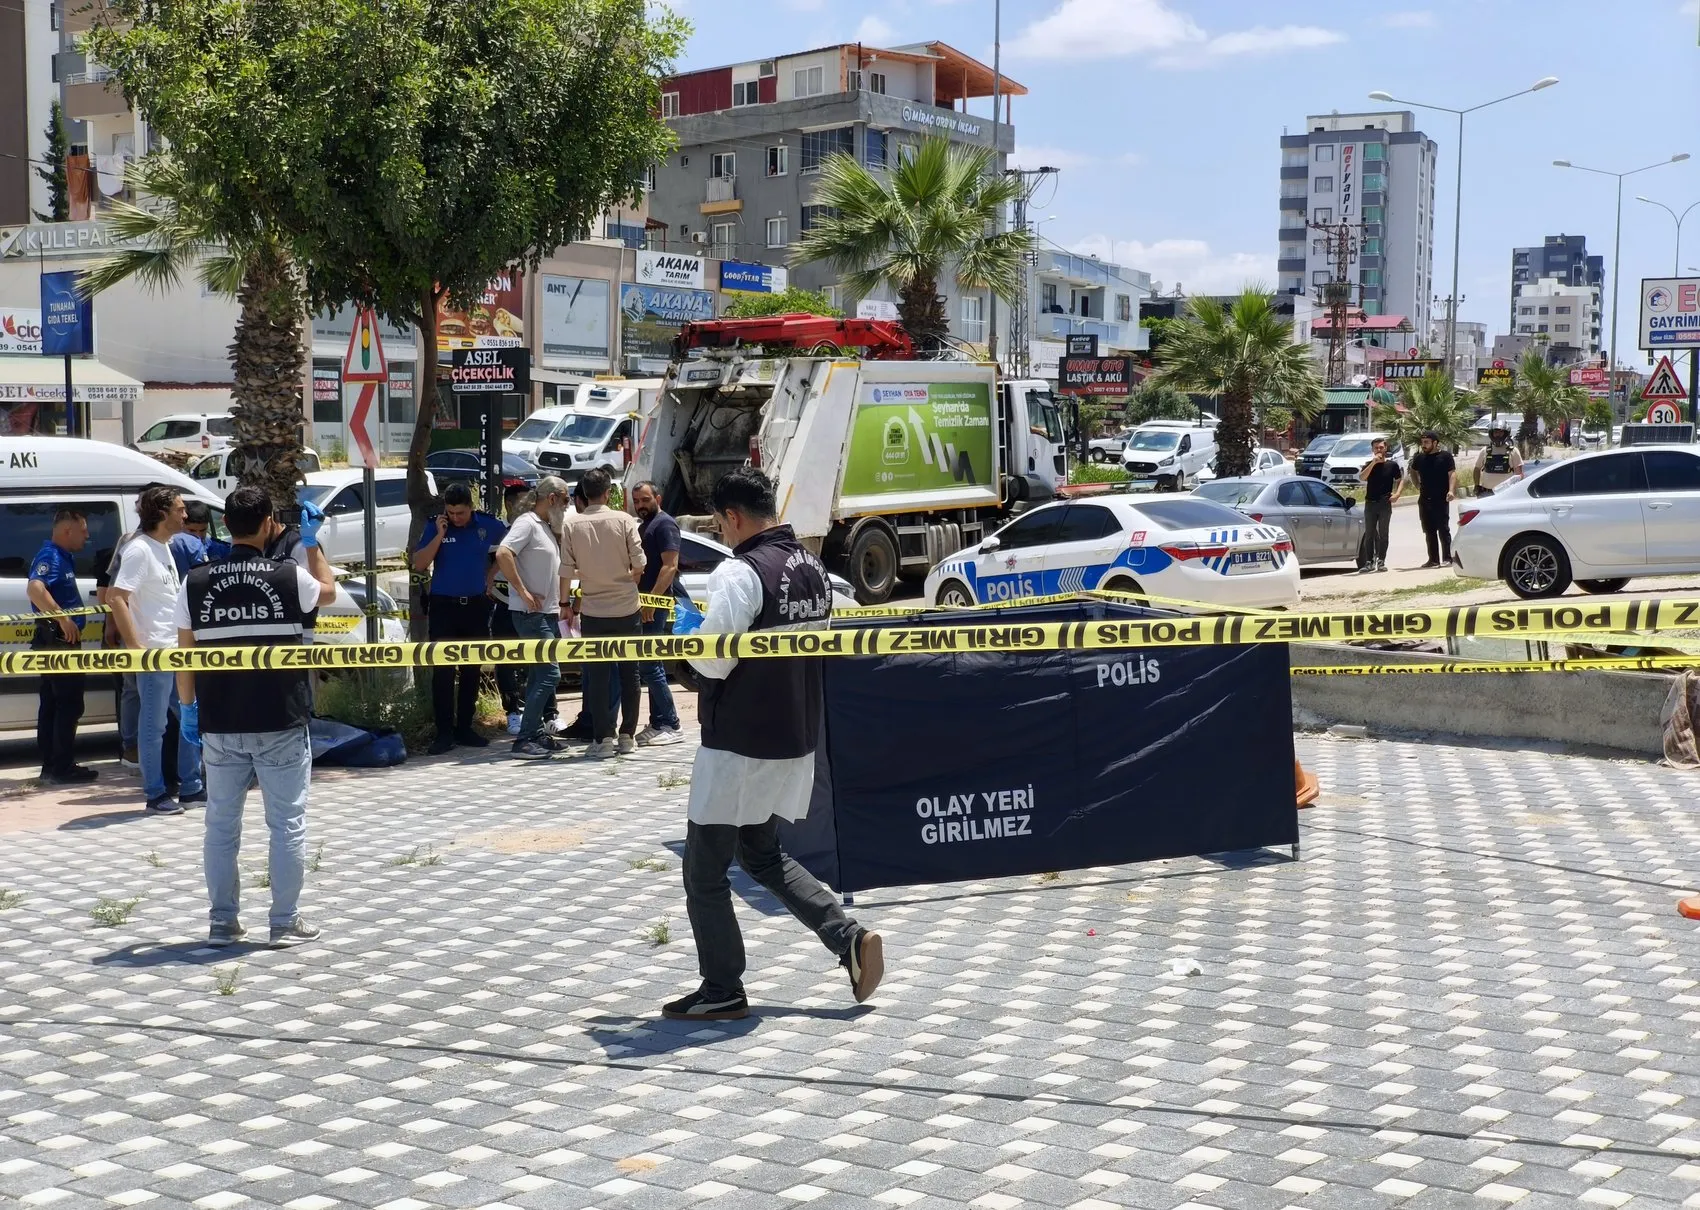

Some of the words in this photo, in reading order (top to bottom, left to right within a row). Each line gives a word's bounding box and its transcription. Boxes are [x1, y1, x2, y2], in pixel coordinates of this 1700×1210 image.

[911, 109, 935, 128] MİRAÇ
[656, 256, 699, 272] AKANA
[665, 271, 691, 280] TARIM
[547, 283, 567, 294] ANT
[49, 301, 76, 312] TUNAHAN
[649, 292, 704, 312] AKANA
[47, 315, 61, 324] GIDA
[61, 313, 78, 323] TEKEL
[662, 311, 693, 321] TARIM
[464, 350, 502, 365] ASEL
[1066, 359, 1099, 371] UMUT
[1101, 359, 1124, 371] OTO
[451, 365, 515, 383] ÇİÇEKÇİLİK
[1066, 373, 1094, 382] LASTİK
[1096, 373, 1102, 382] &
[1104, 371, 1122, 382] AKÜ
[932, 401, 969, 415] Seyhan'da
[1654, 408, 1674, 424] 30
[933, 415, 963, 428] Temizlik
[963, 416, 989, 426] Zamanı
[1132, 531, 1145, 541] 112
[208, 560, 274, 575] KRİMİNAL
[1235, 553, 1243, 563] 01
[1247, 553, 1252, 562] A
[200, 590, 216, 623] OLAY
[213, 572, 240, 593] YERİ
[243, 572, 284, 619] İNCELEME
[779, 571, 791, 615] OLAY
[986, 574, 1034, 602] POLİS
[214, 603, 269, 622] POLİS
[788, 594, 826, 621] POLİS
[1255, 613, 1433, 639] GİRİLMEZ
[1492, 606, 1611, 631] POLİS
[15, 629, 32, 637] OLAY
[889, 626, 1045, 650] GİRİLMEZ
[1098, 621, 1201, 645] POLİS
[444, 642, 525, 662] POLİS
[567, 636, 705, 660] GİRİLMEZ
[749, 633, 842, 654] POLİS
[21, 652, 132, 671] GİRİLMEZ
[169, 650, 243, 668] POLİS
[280, 646, 402, 666] GİRİLMEZ
[1096, 654, 1161, 688] POLİS
[916, 793, 975, 819] OLAY
[981, 783, 1034, 812] YERİ
[921, 814, 1032, 845] GİRİLMEZ
